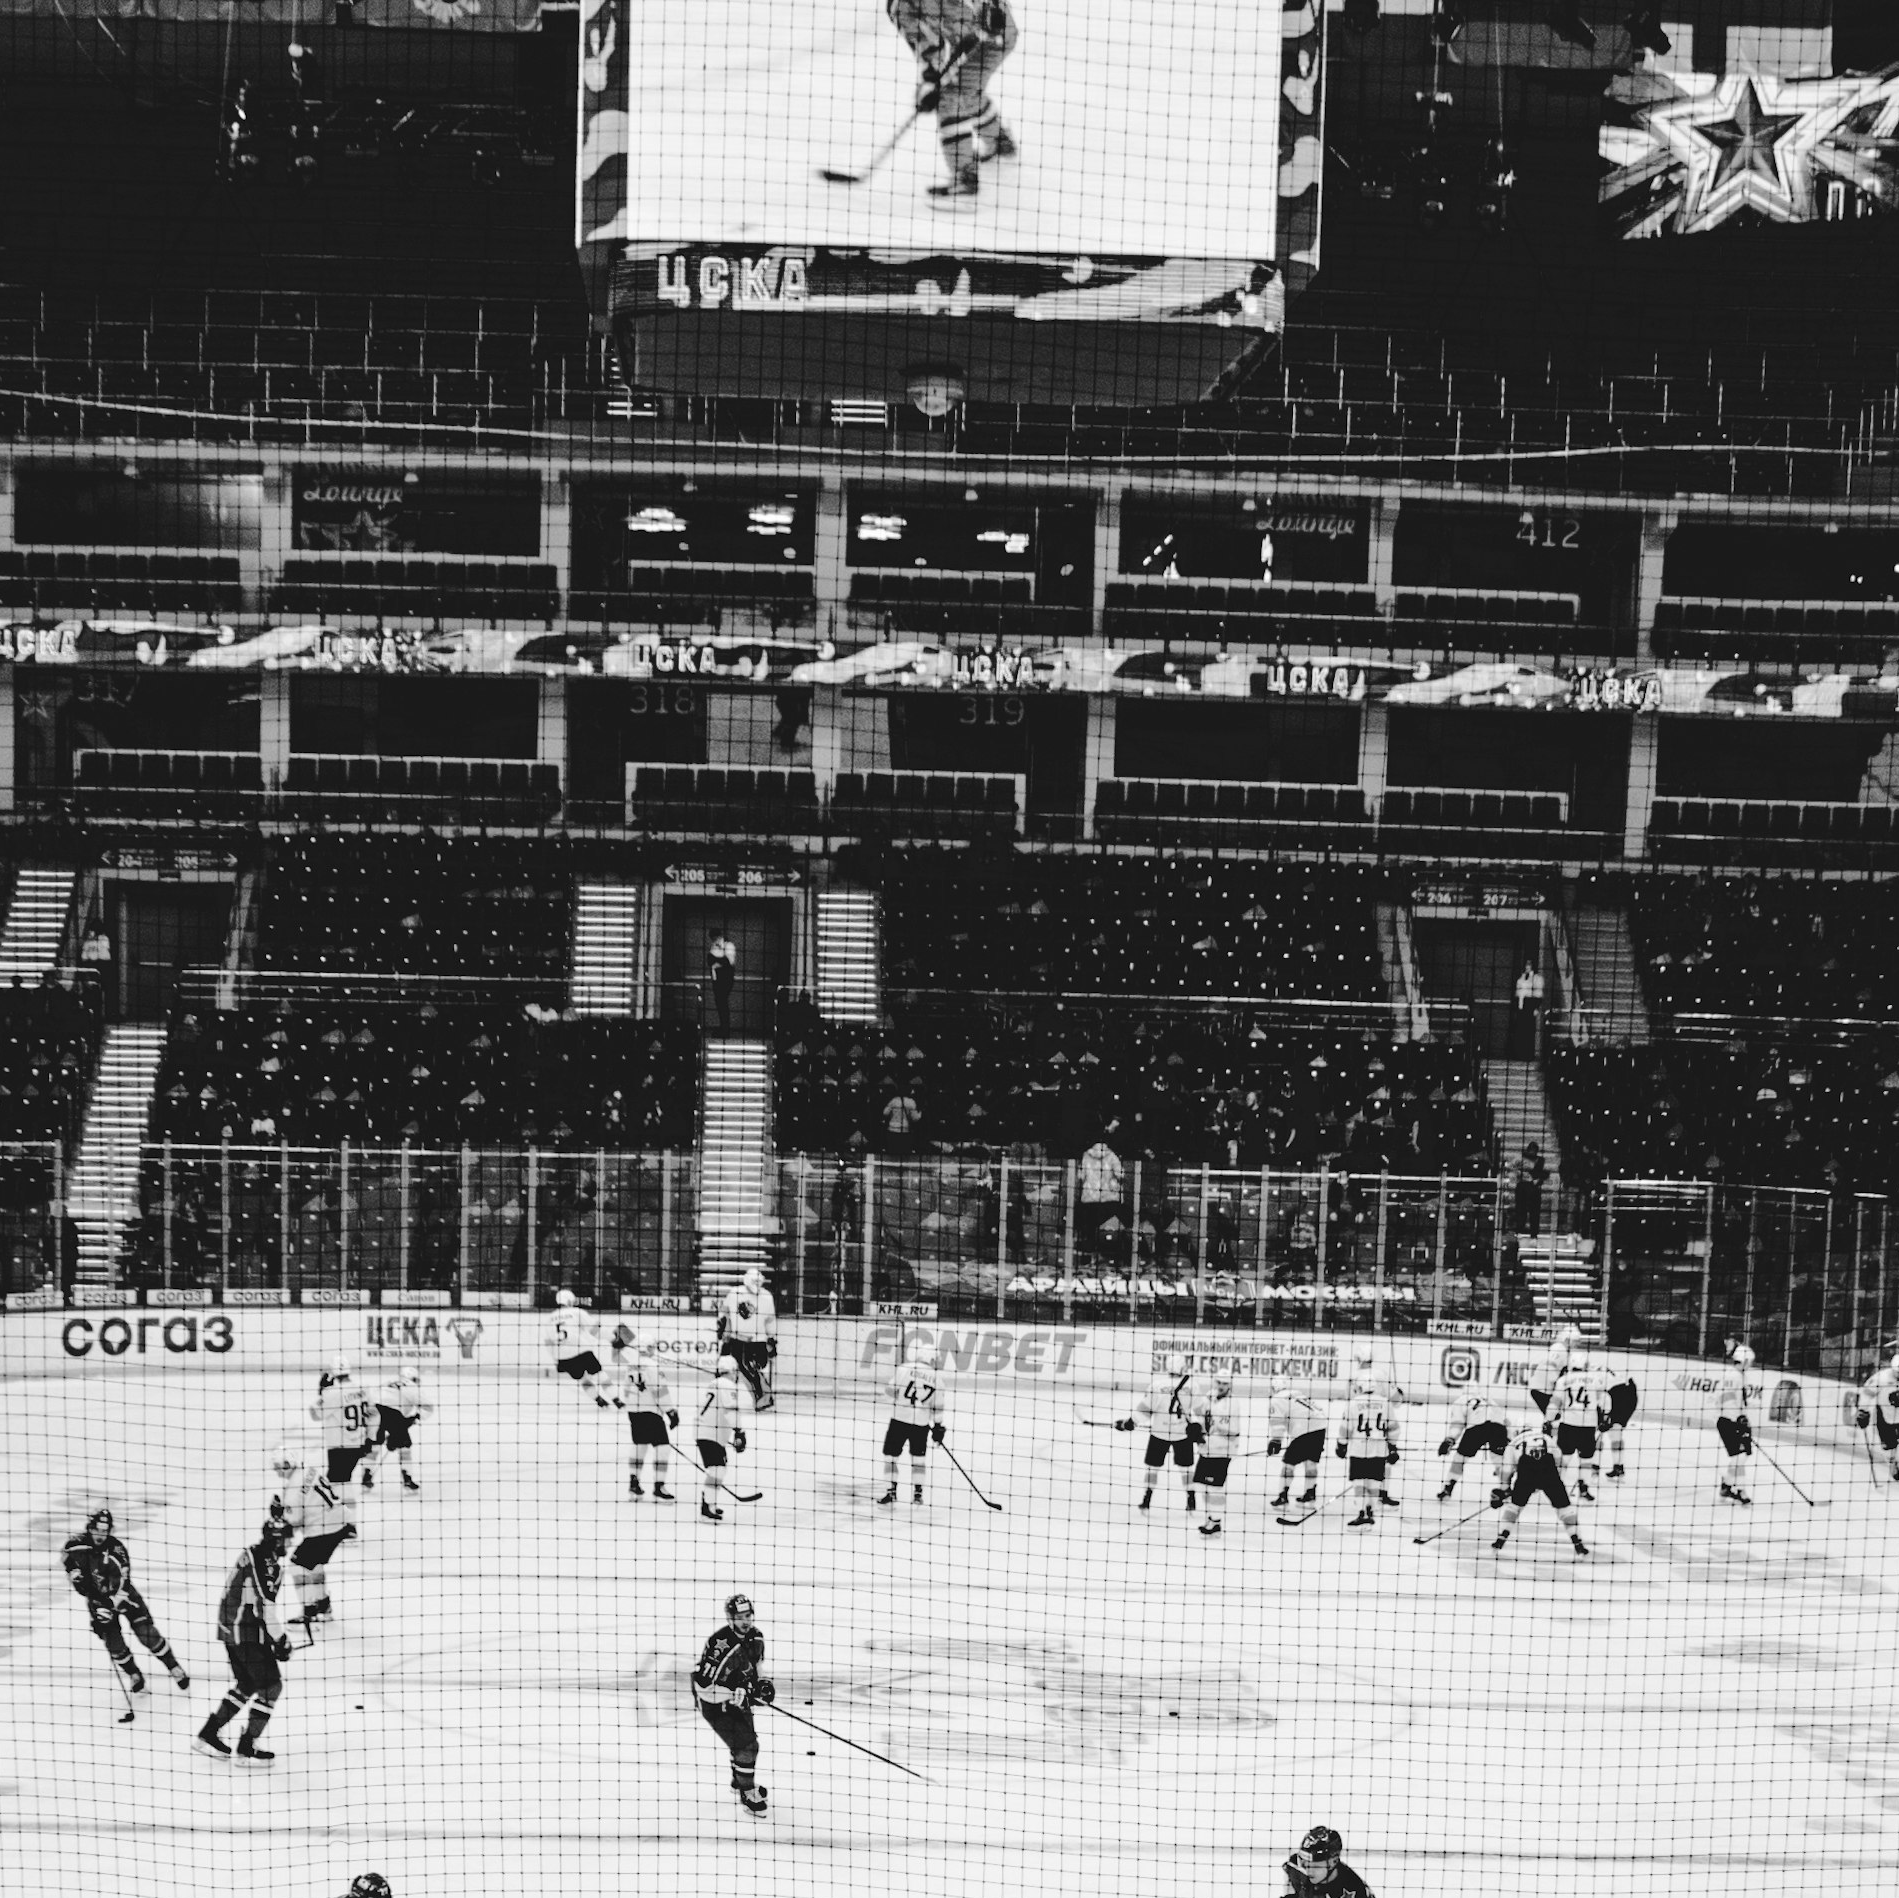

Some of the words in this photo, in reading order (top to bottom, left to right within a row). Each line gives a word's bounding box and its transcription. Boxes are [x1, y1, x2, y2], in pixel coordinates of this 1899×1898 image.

[657, 256, 807, 309] ЦСКА
[1516, 516, 1580, 548] 412
[315, 637, 396, 666] ЦСКА
[633, 645, 715, 673] ЦСКА
[952, 654, 1033, 684] ЦСКА
[1267, 665, 1349, 696] ЦСКА
[630, 684, 695, 714] 318
[1580, 678, 1663, 708] ЦСКА
[959, 696, 1025, 725] 319
[14, 1292, 57, 1308] согаз
[156, 1289, 204, 1304] согаз
[233, 1291, 282, 1304] согаз
[311, 1290, 361, 1304] согаз
[1005, 1276, 1190, 1297] АРМЕЙЦЫ
[1262, 1284, 1416, 1301] МОСКВЫ
[629, 1298, 680, 1312] KHL.RU
[878, 1303, 929, 1317] KHL.RU
[62, 1316, 234, 1357] согаз
[367, 1316, 440, 1348] ЦСКА
[555, 1322, 568, 1343] 5
[1435, 1322, 1484, 1336] KHL.RU
[1151, 1340, 1232, 1354] ОФИЦИАЛЬНЫЙ
[1151, 1355, 1339, 1379] S.CSKA-HOCKEY.RU
[903, 1380, 936, 1405] 47
[1356, 1412, 1389, 1438] 44
